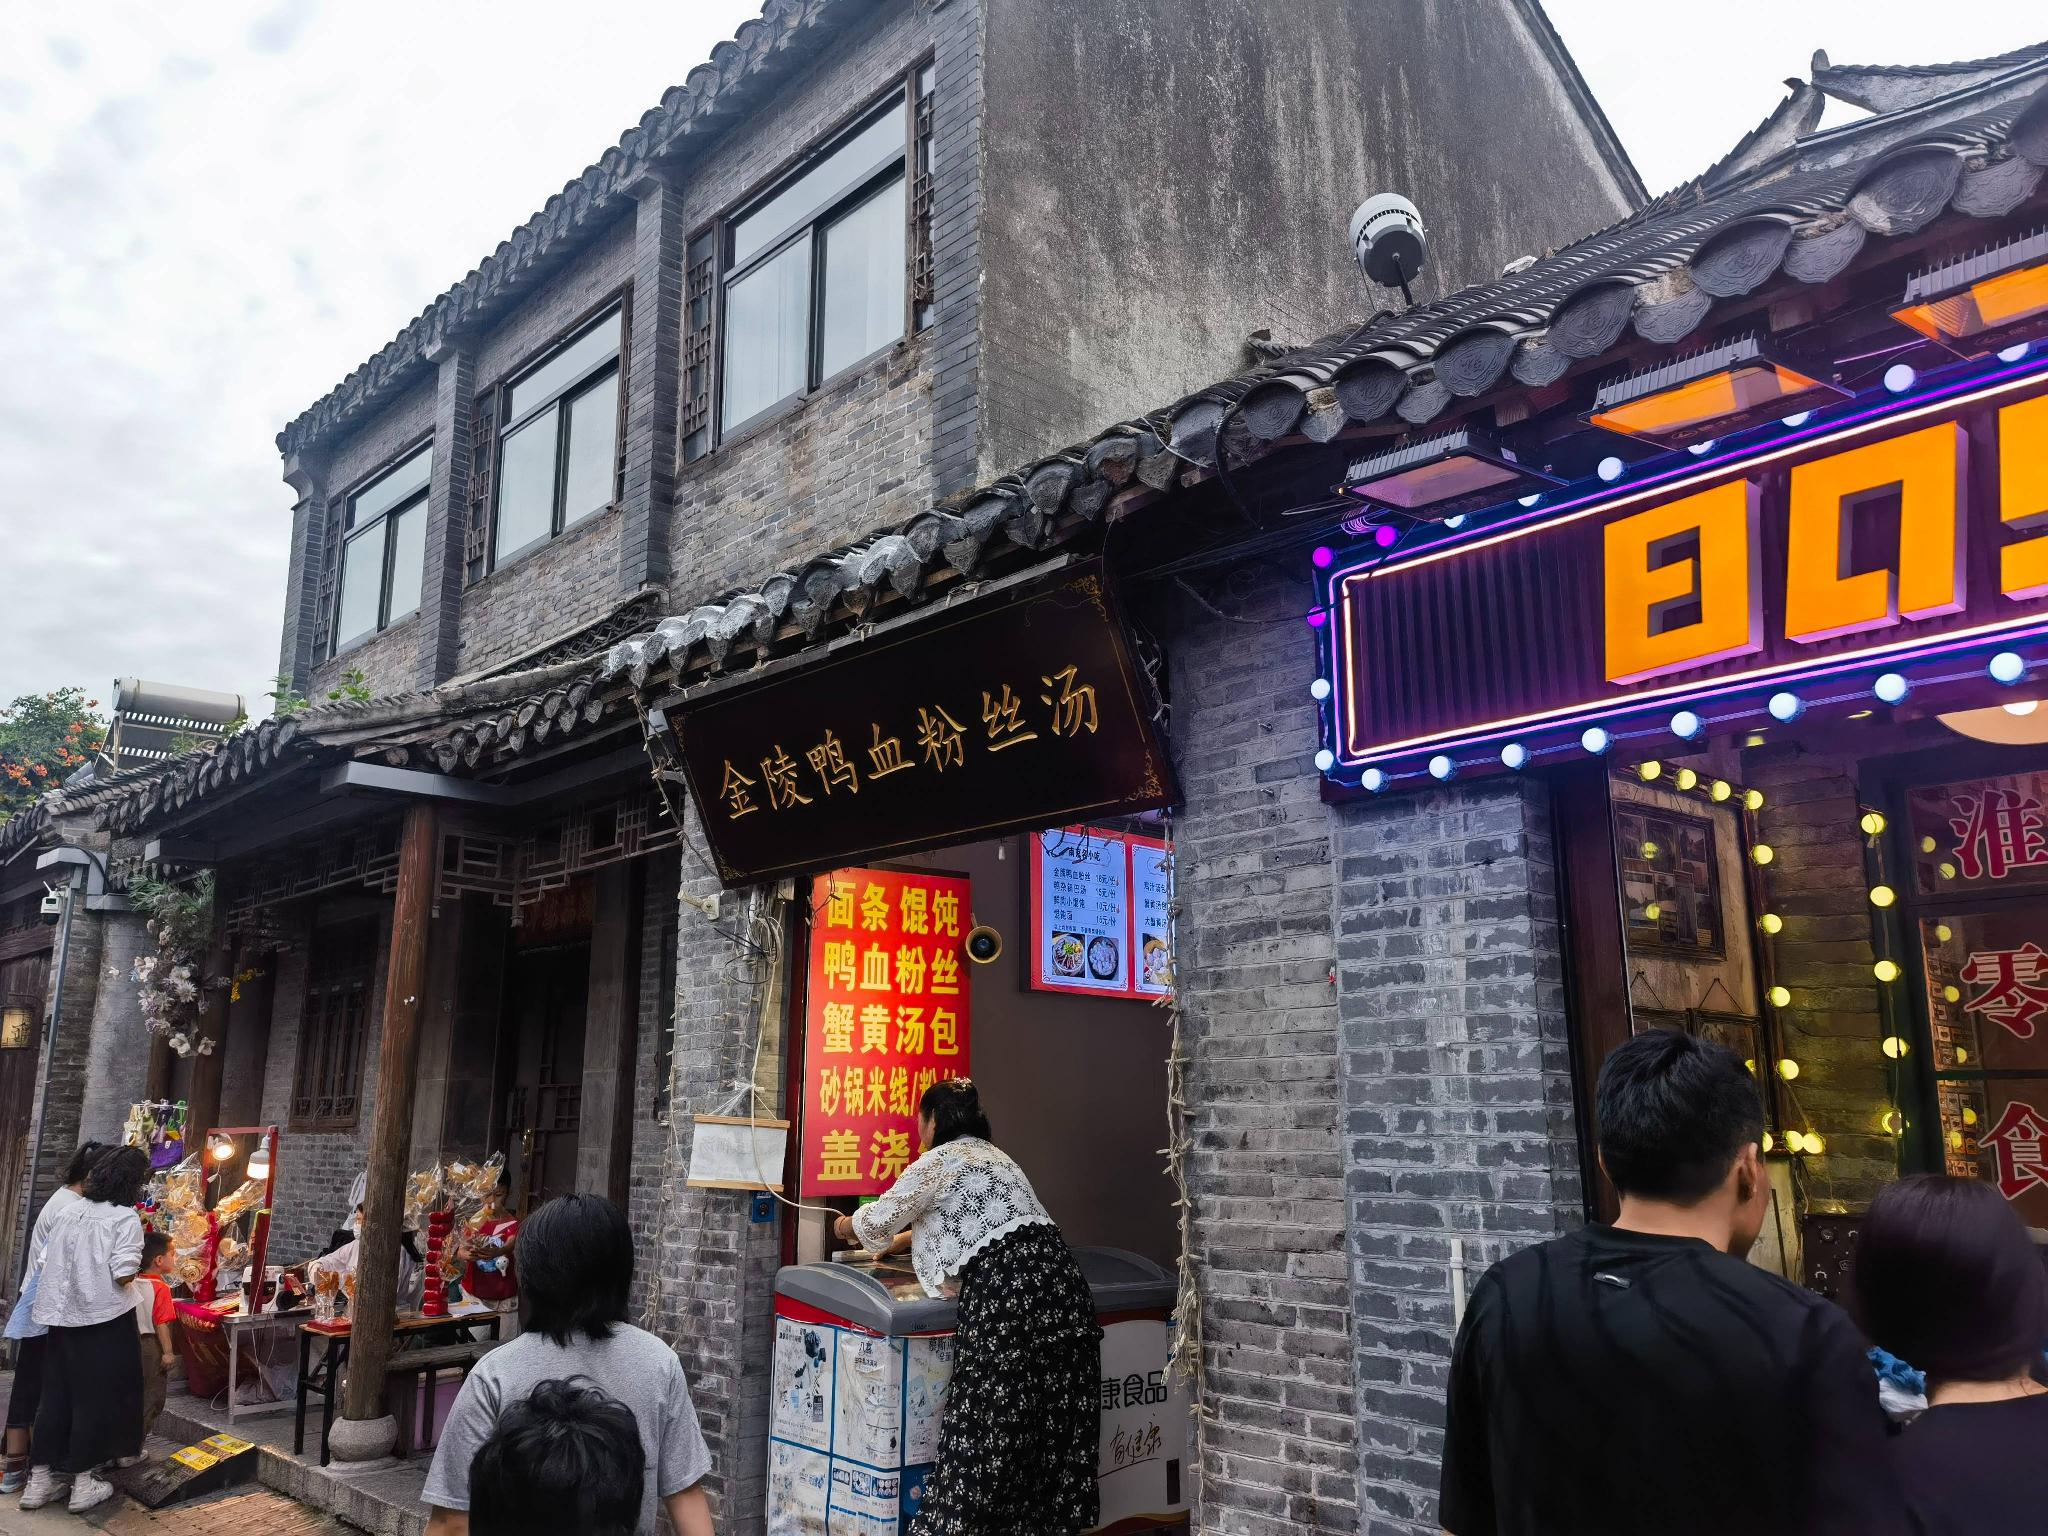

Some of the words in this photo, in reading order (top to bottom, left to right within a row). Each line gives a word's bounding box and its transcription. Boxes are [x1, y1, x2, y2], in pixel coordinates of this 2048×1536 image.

[718, 664, 1099, 820] 金陵鸭血粉丝汤
[826, 880, 890, 931] 面条
[900, 886, 960, 938] 馄饨
[823, 939, 960, 995] 鸭血粉丝
[822, 1001, 960, 1056] 蟹黄汤包
[817, 1128, 927, 1181] 盖浇
